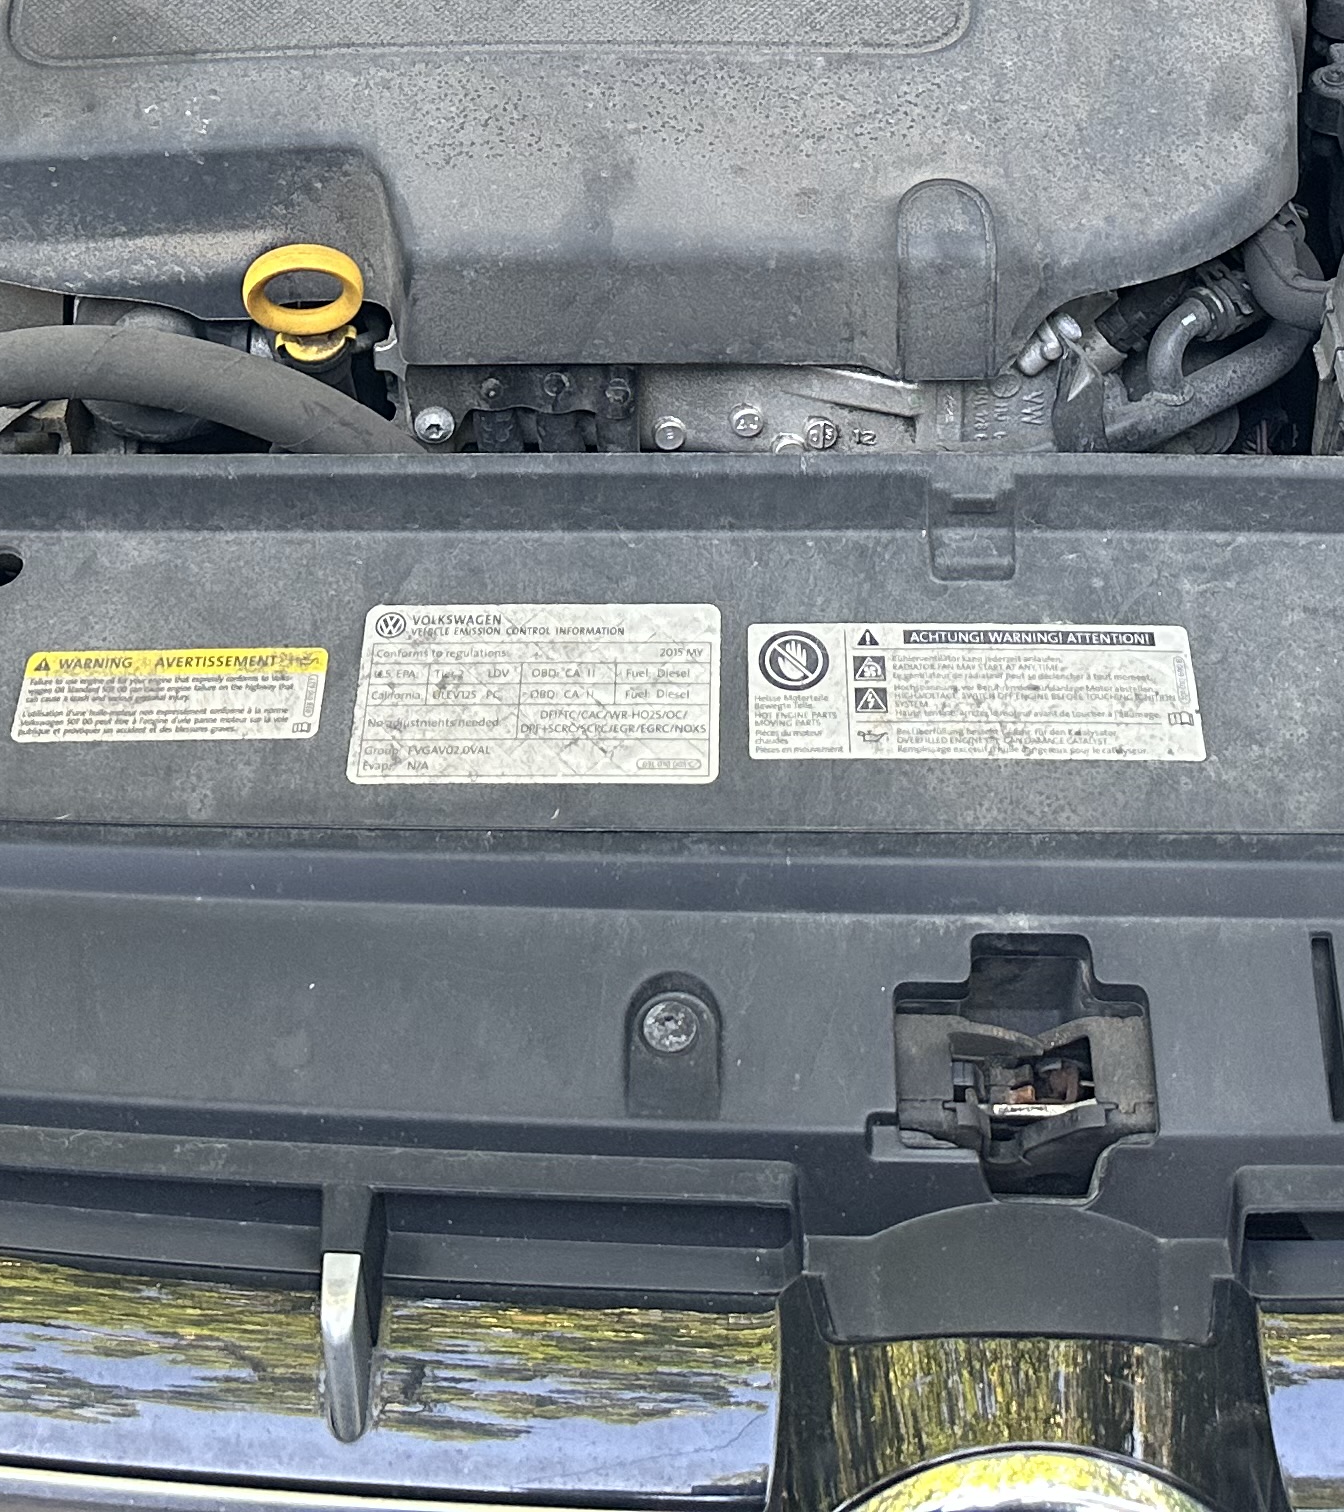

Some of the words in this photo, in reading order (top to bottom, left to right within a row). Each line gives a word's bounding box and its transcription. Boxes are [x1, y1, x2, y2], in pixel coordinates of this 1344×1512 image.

[412, 614, 502, 625] VOLKSWAGEN
[453, 626, 501, 635] EMISSION
[505, 626, 551, 635] CONTROL
[556, 626, 625, 635] INFORMATION
[909, 631, 984, 644] ACHTUNG!
[988, 631, 1062, 644] WARNING!
[1067, 633, 1150, 645] ATTENTION!
[376, 648, 428, 658] Conforms
[432, 649, 443, 658] to
[659, 648, 683, 657] 2015
[686, 648, 703, 657] MY
[59, 657, 132, 669] WARNING
[154, 654, 276, 668] AVERTISSEMENT
[487, 669, 509, 678] LDV
[566, 669, 580, 678] CA
[657, 669, 690, 678] Diesel
[432, 690, 476, 700] ULEV125
[564, 690, 579, 698] CA
[656, 690, 690, 699] Diesel
[368, 719, 381, 727] No
[457, 717, 499, 727] needed
[1051, 728, 1065, 736] den
[407, 762, 429, 771] N/A
